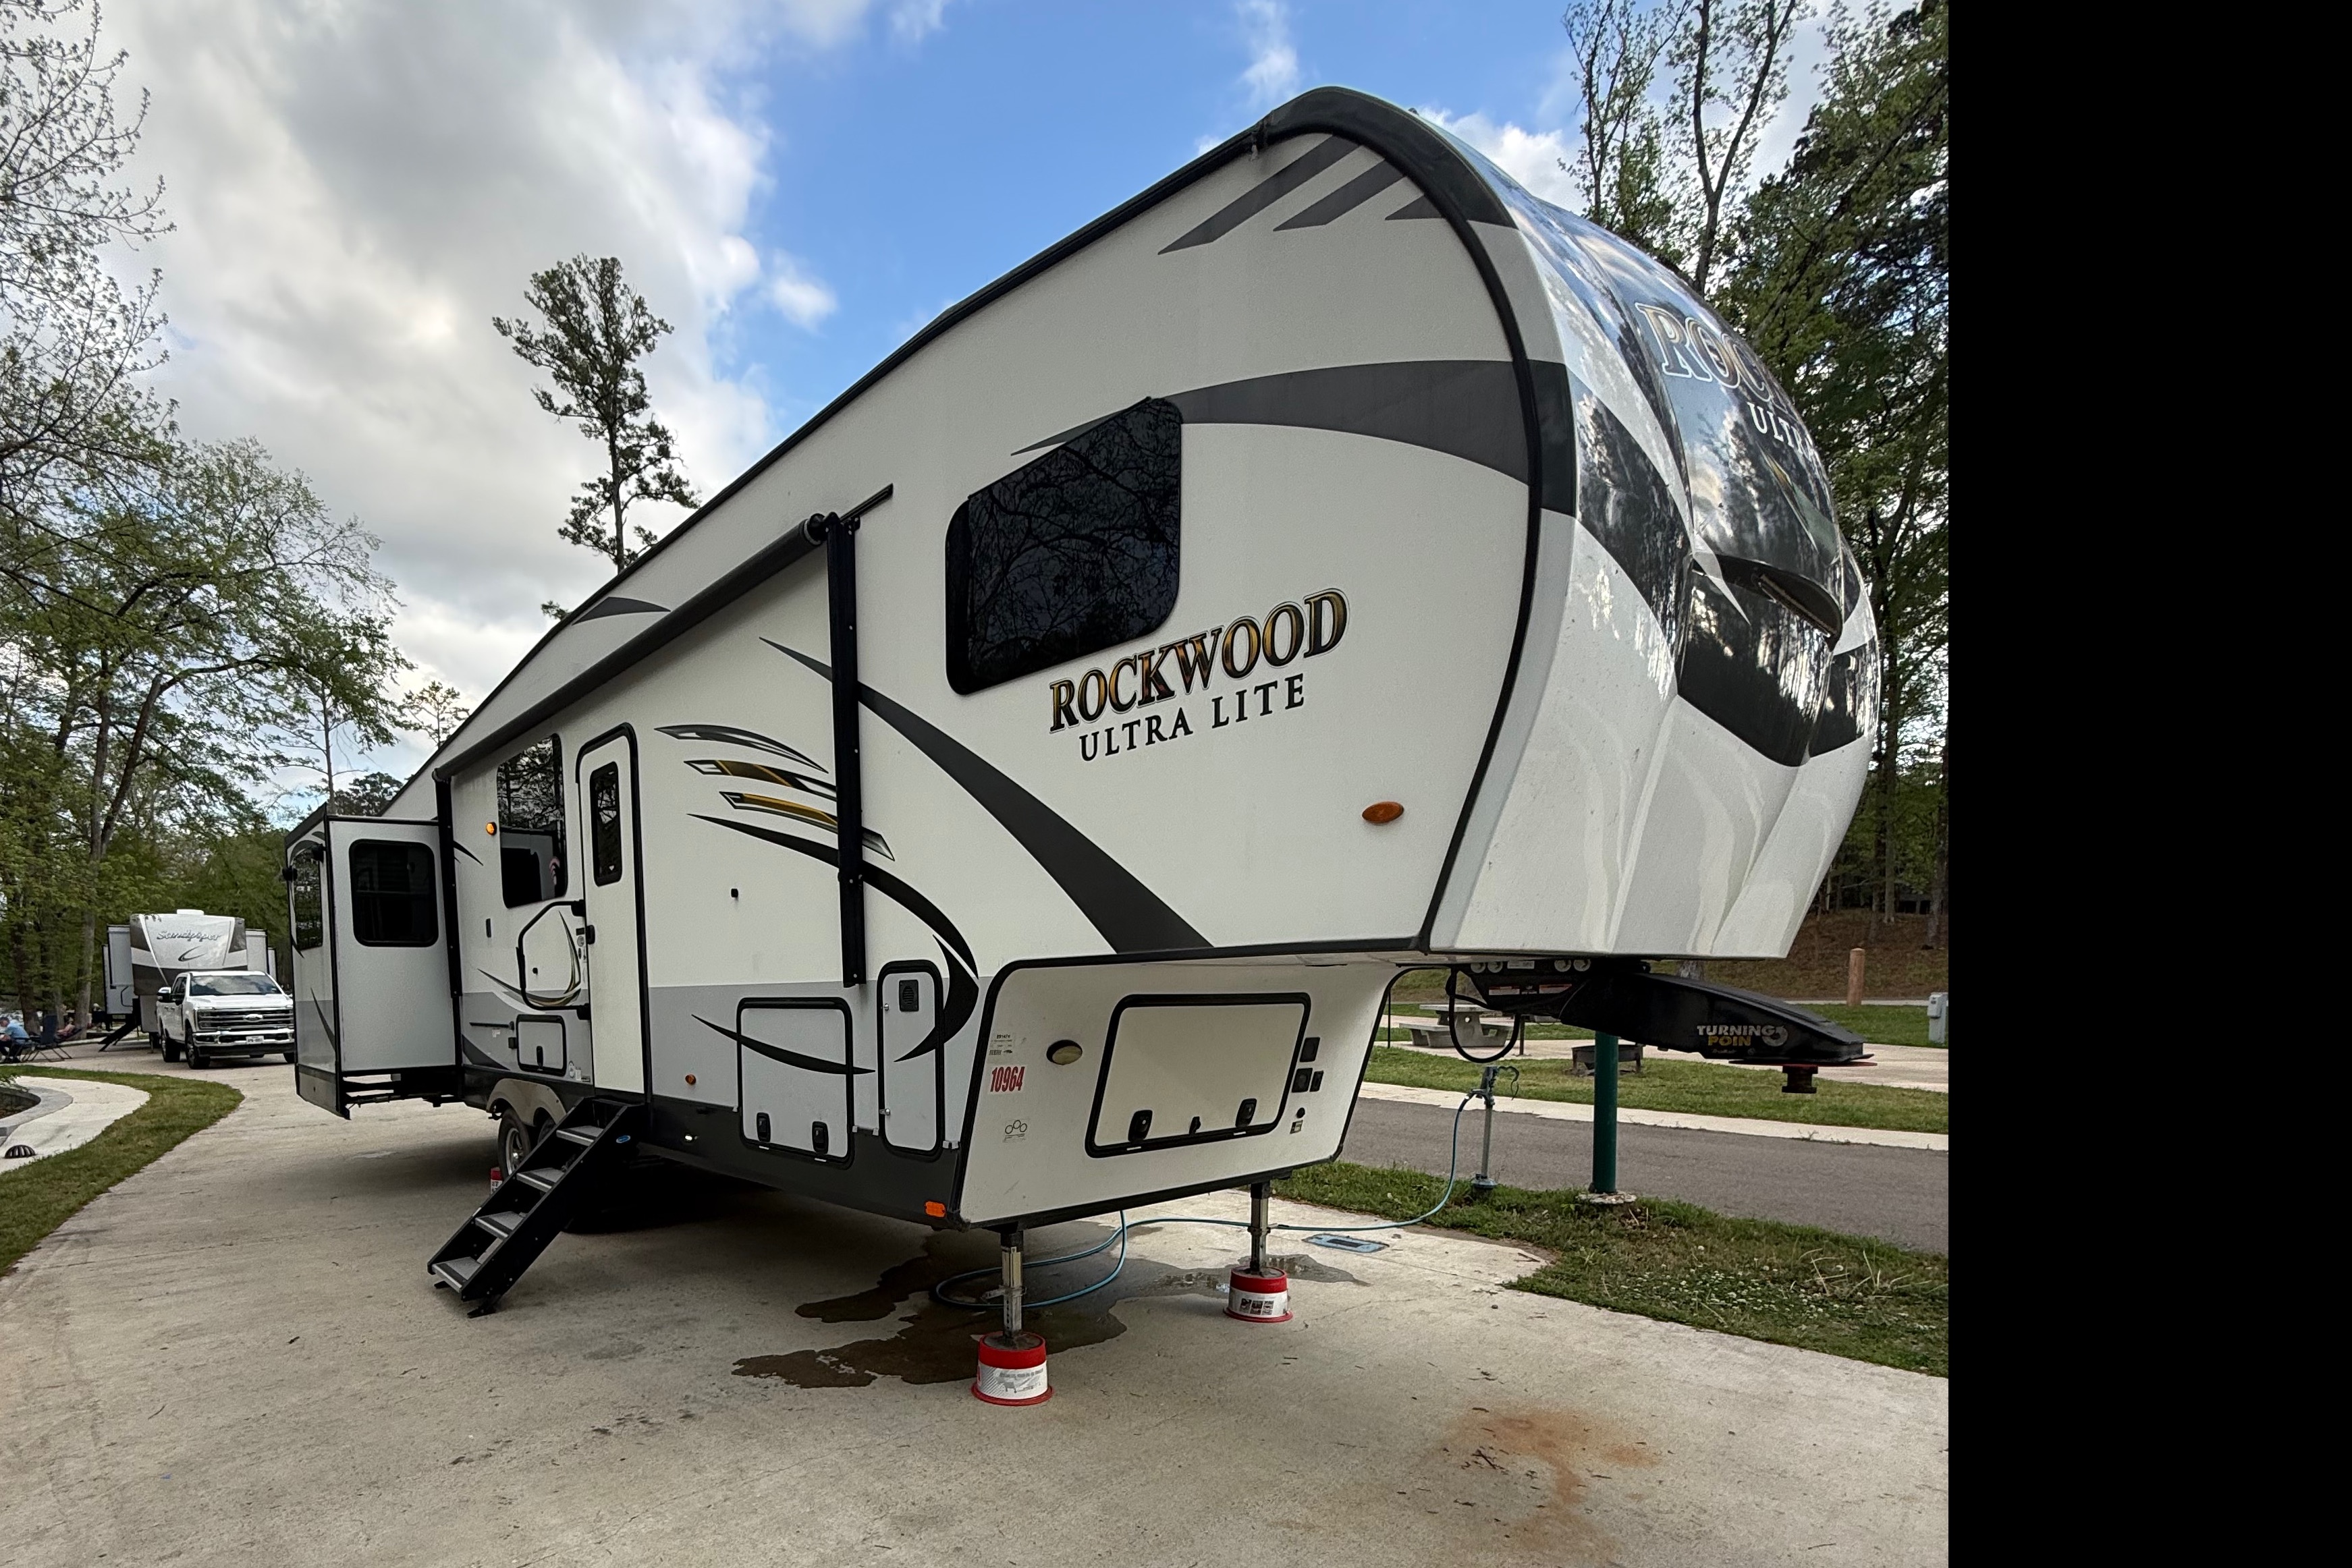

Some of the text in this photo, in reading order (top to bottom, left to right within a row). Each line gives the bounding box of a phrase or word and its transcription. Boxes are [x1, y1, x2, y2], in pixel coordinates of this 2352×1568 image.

[1049, 588, 1349, 733] ROCKWOOD
[1078, 673, 1305, 762] ULTRA LITE
[157, 929, 221, 943] Sandpiper
[1696, 1025, 1776, 1036] TURNING
[989, 1066, 1025, 1092] 10964
